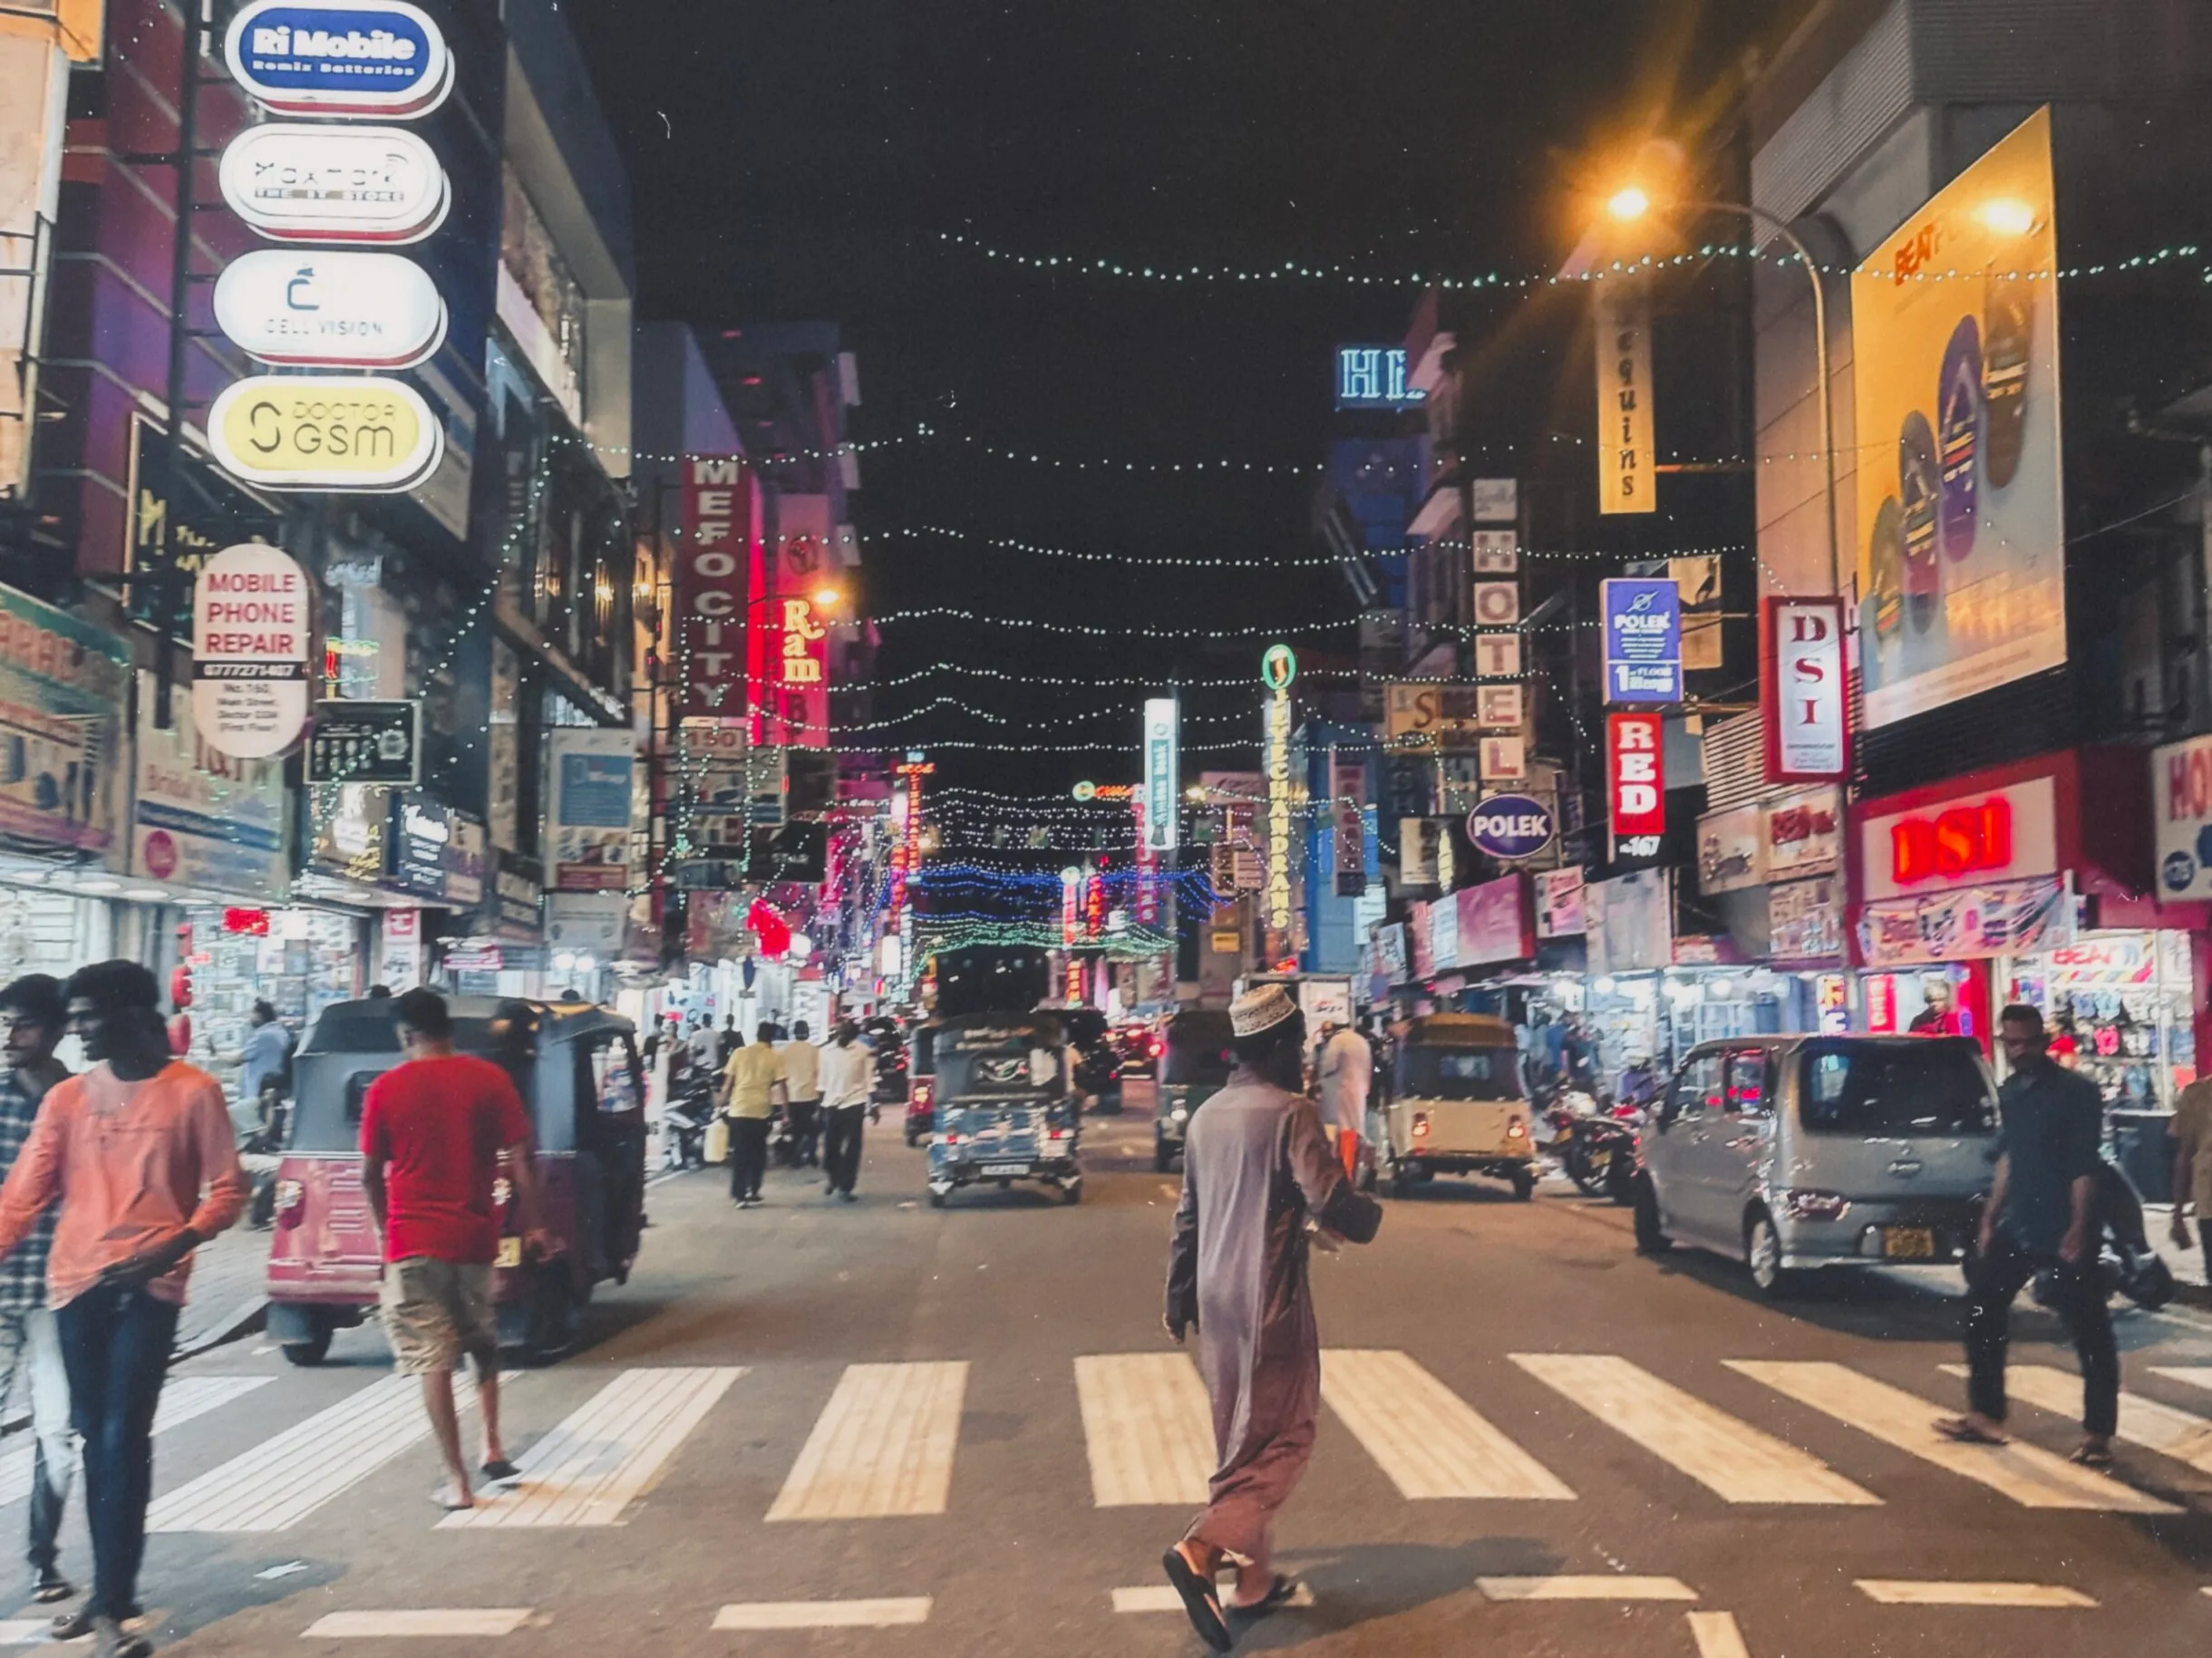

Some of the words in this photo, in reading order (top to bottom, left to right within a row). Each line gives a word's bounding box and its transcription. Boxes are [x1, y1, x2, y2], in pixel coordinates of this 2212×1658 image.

[253, 25, 291, 55] Ri
[293, 29, 416, 60] Mobile
[207, 574, 296, 593] MOBILE
[207, 602, 296, 624] PHONE
[1614, 611, 1672, 629] POLEK
[205, 633, 295, 654] REPAIR
[782, 599, 825, 683] Ram
[1475, 533, 1518, 776] HOTEL
[1790, 616, 1828, 725] DSI
[1618, 722, 1656, 814] RED
[1473, 815, 1548, 839] POLEK
[1892, 796, 2012, 885] DSI
